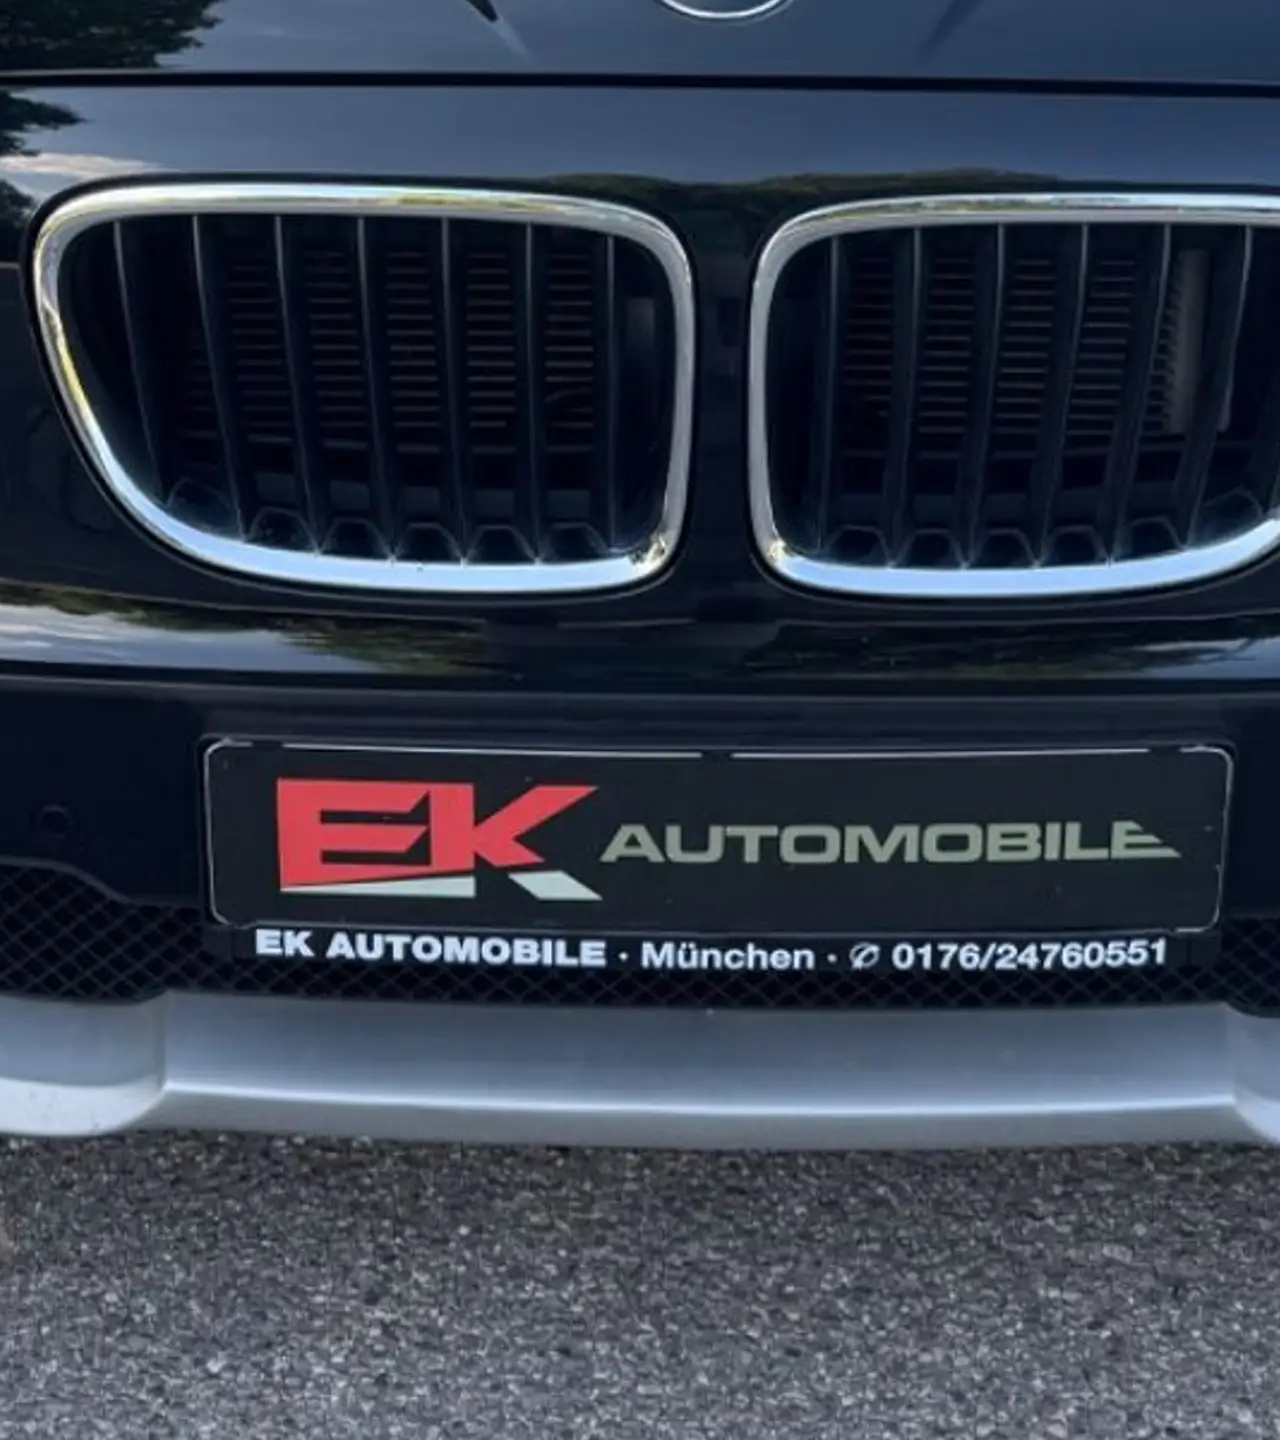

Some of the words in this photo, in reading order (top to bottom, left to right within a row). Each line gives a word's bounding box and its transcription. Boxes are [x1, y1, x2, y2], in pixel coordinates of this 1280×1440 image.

[276, 776, 604, 901] EK
[599, 820, 1183, 864] AUTOMOBILE
[255, 928, 315, 957] EK
[325, 930, 607, 968] AUTOMOBILE
[640, 940, 815, 971] München
[891, 937, 1167, 971] 0176/24760551
